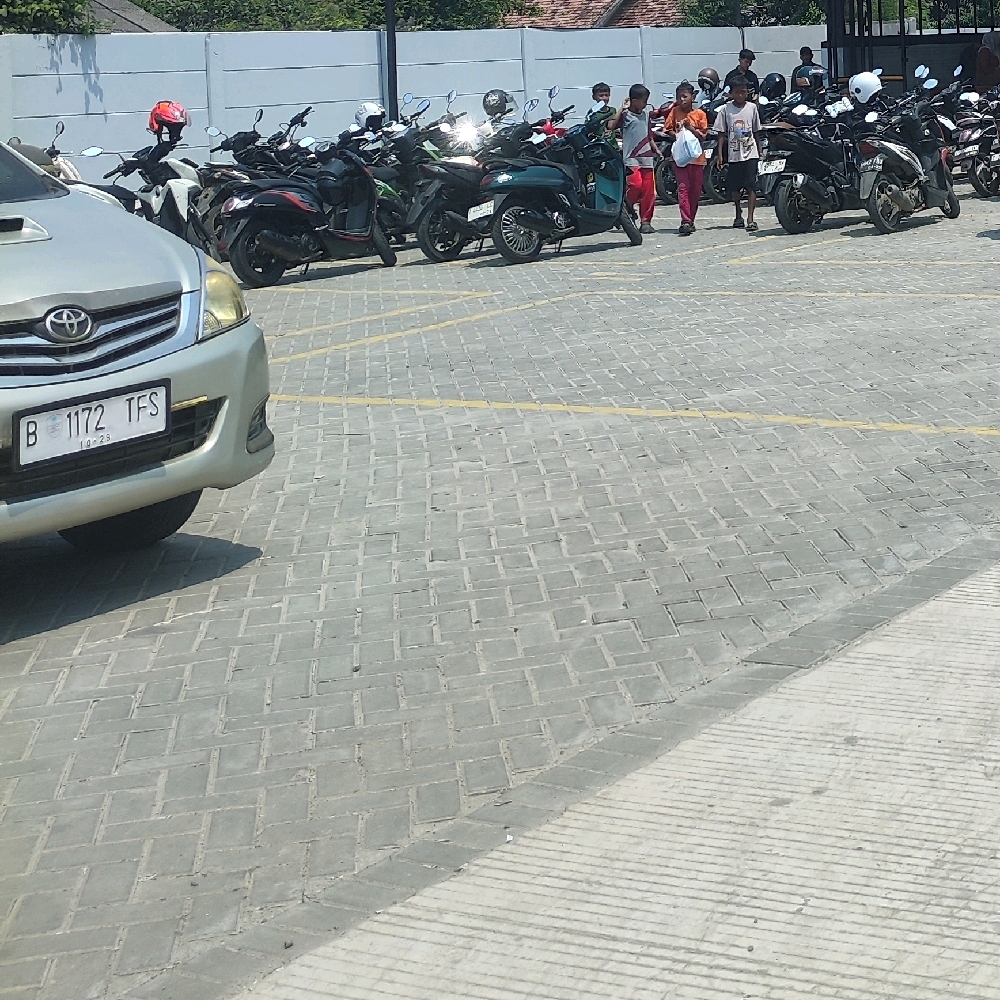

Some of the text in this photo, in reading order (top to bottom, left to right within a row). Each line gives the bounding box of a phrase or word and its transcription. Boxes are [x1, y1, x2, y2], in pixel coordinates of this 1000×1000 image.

[26, 391, 160, 448] B 1172 TFS
